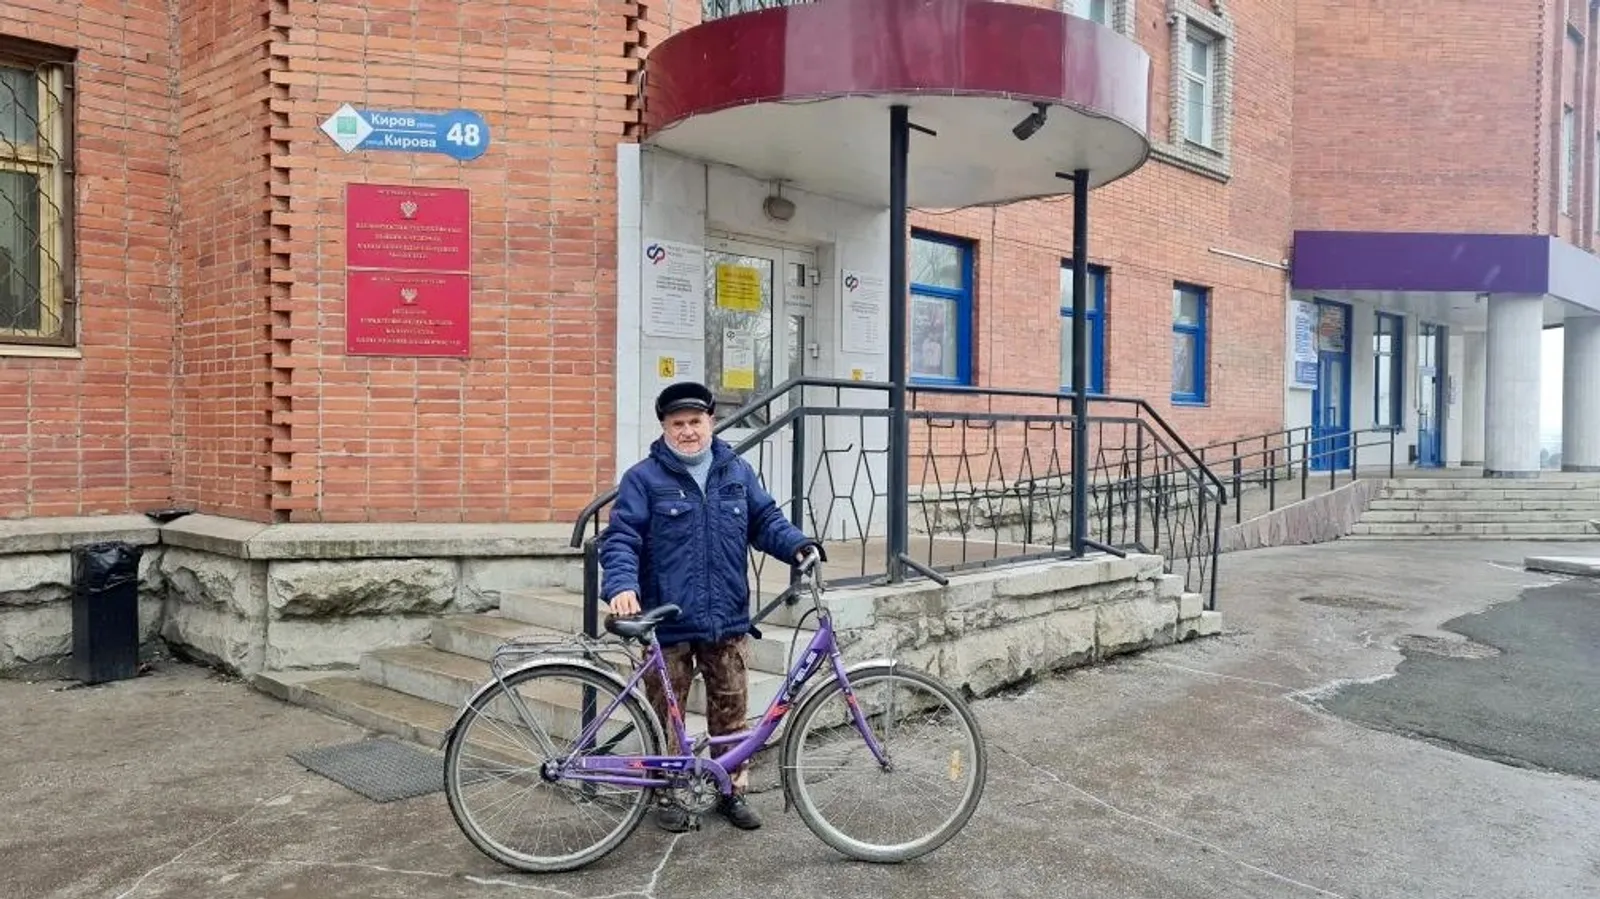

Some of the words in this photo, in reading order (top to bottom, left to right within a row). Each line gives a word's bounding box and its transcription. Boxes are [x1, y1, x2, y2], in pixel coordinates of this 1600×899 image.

[371, 113, 416, 128] Киров
[384, 134, 437, 148] Кирова
[446, 123, 480, 147] 48
